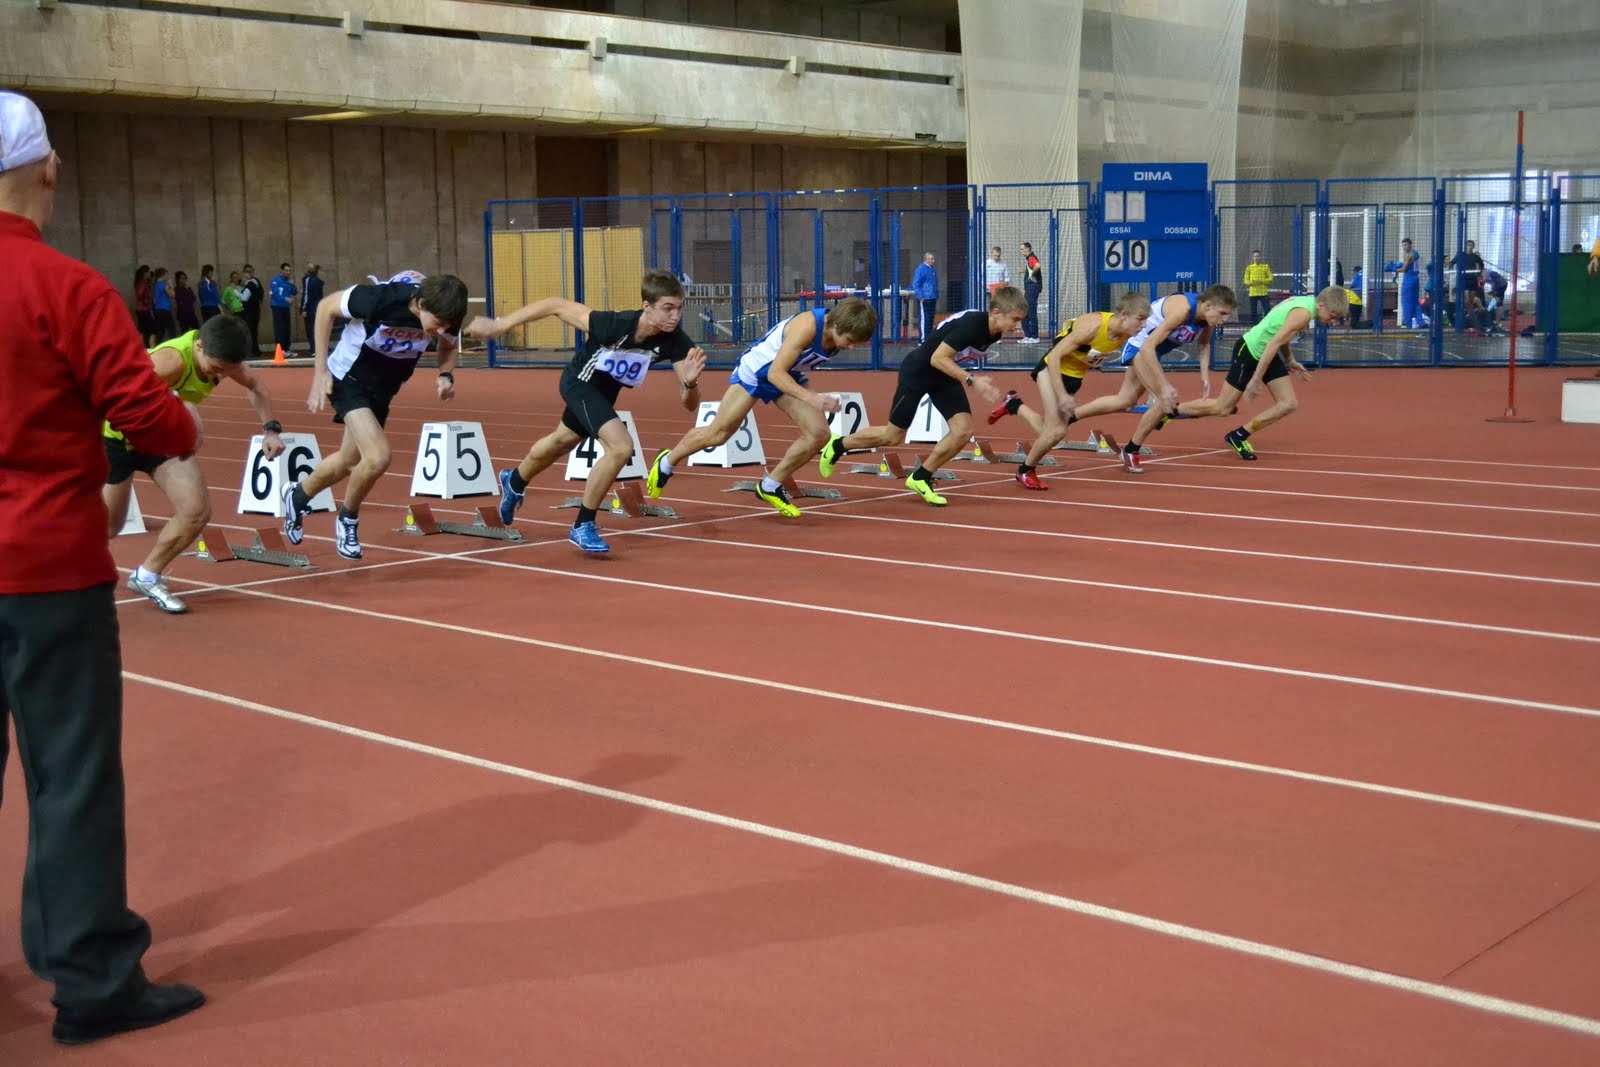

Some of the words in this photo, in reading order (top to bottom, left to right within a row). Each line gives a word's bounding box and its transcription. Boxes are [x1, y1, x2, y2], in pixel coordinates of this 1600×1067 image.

[1134, 171, 1172, 181] DIMA
[1109, 226, 1131, 234] ESSAI
[1105, 240, 1146, 268] 60
[604, 359, 642, 380] 299
[921, 396, 932, 432] 1
[423, 432, 442, 481] 5
[456, 431, 482, 481] 5
[575, 437, 598, 468] 4
[251, 448, 273, 501] 6
